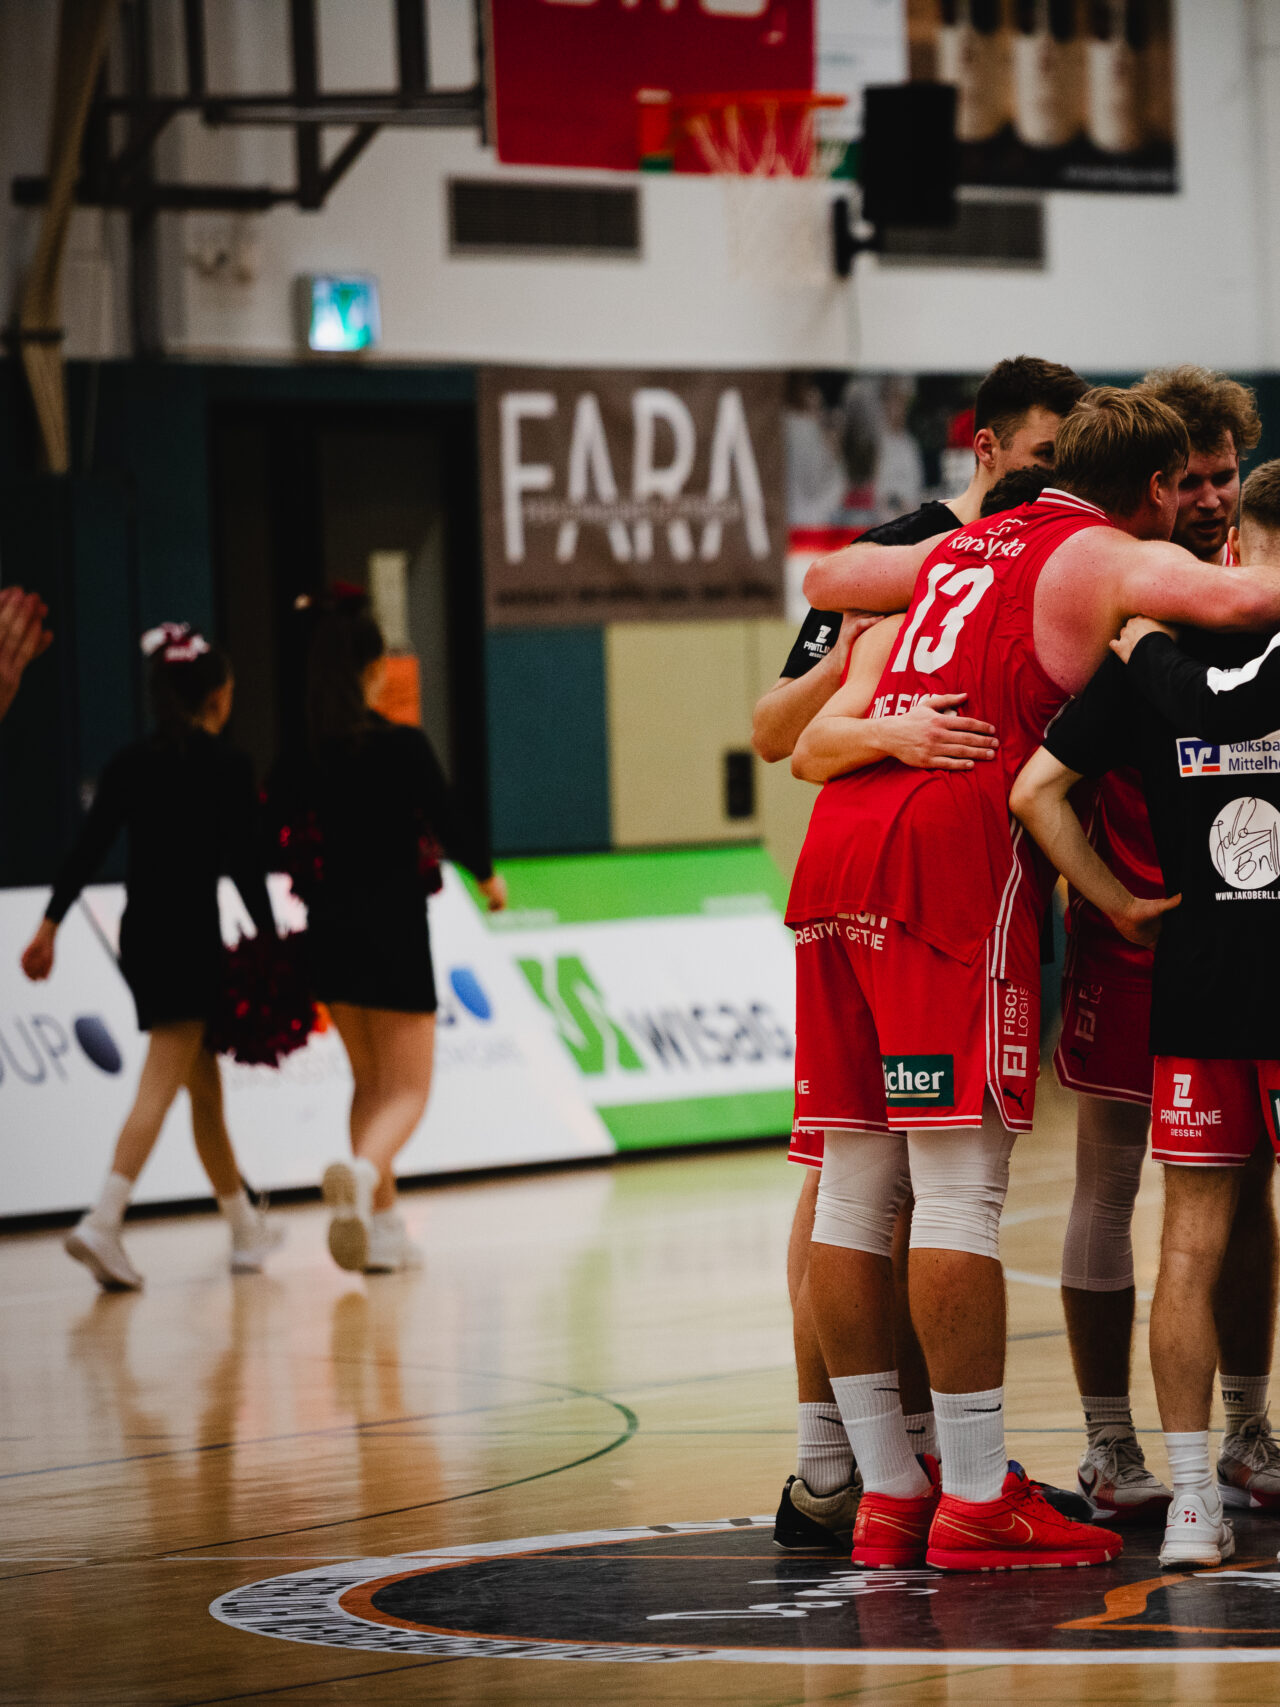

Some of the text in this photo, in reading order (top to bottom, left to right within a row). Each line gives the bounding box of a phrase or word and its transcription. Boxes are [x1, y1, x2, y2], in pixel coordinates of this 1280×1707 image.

[501, 389, 768, 563] FARA
[891, 563, 995, 675] 13
[882, 1062, 944, 1097] icher
[1160, 1109, 1222, 1126] PRINTLINE
